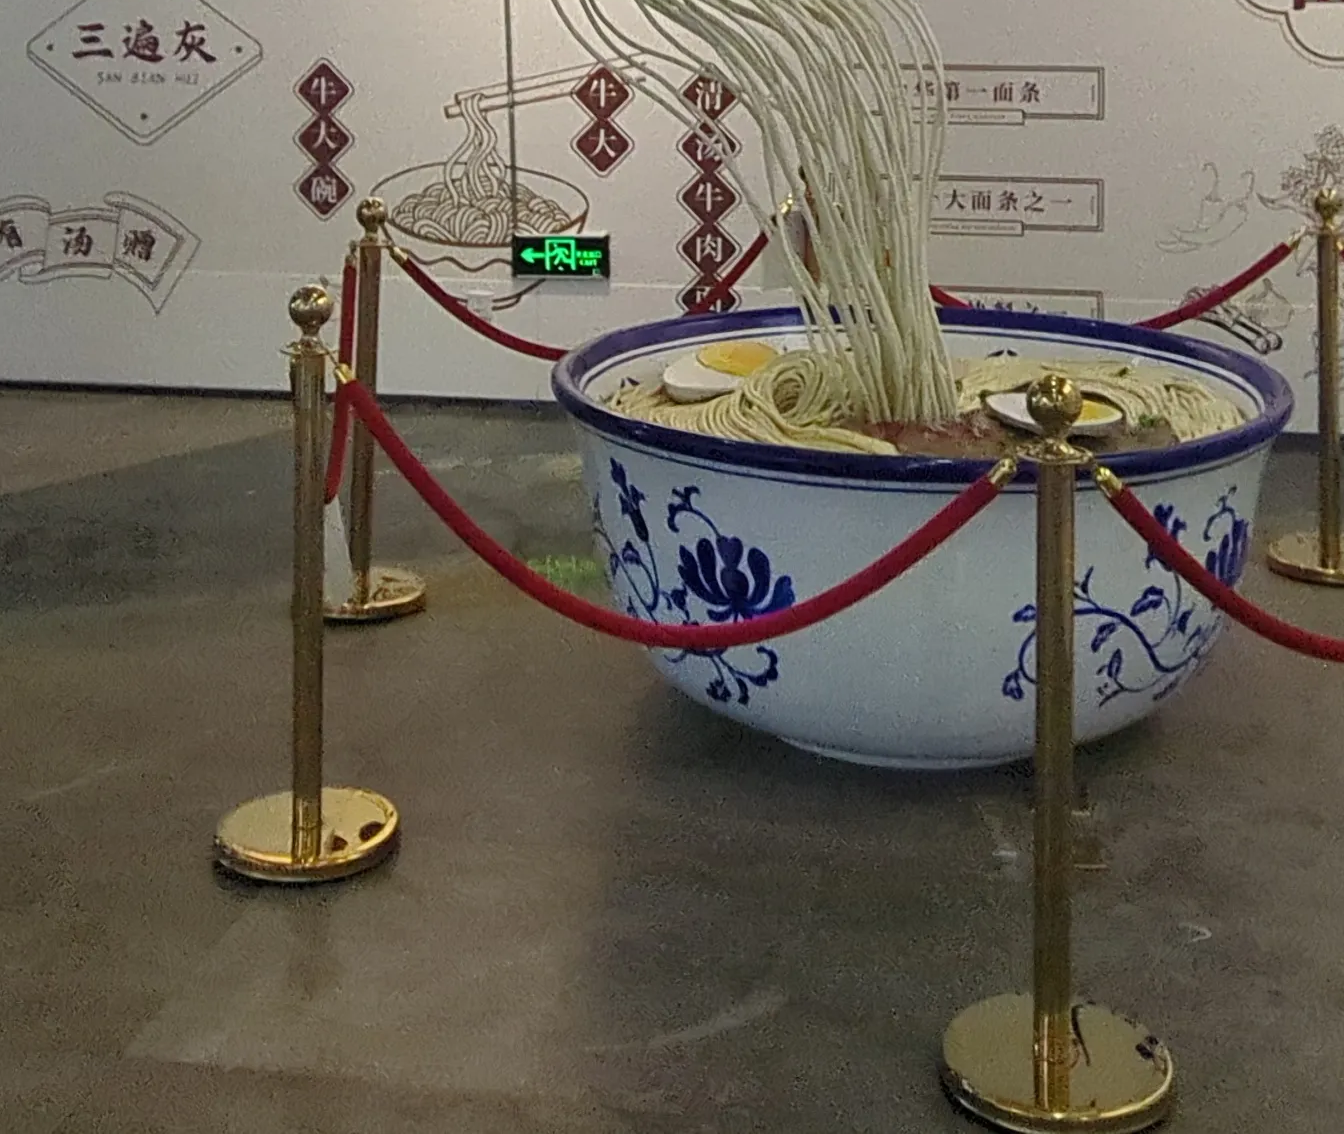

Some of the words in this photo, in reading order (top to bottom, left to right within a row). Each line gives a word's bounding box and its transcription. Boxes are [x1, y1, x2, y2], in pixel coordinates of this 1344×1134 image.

[70, 20, 218, 65] 三遍灰
[310, 76, 338, 204] 牛大碗
[588, 77, 618, 158] 牛大
